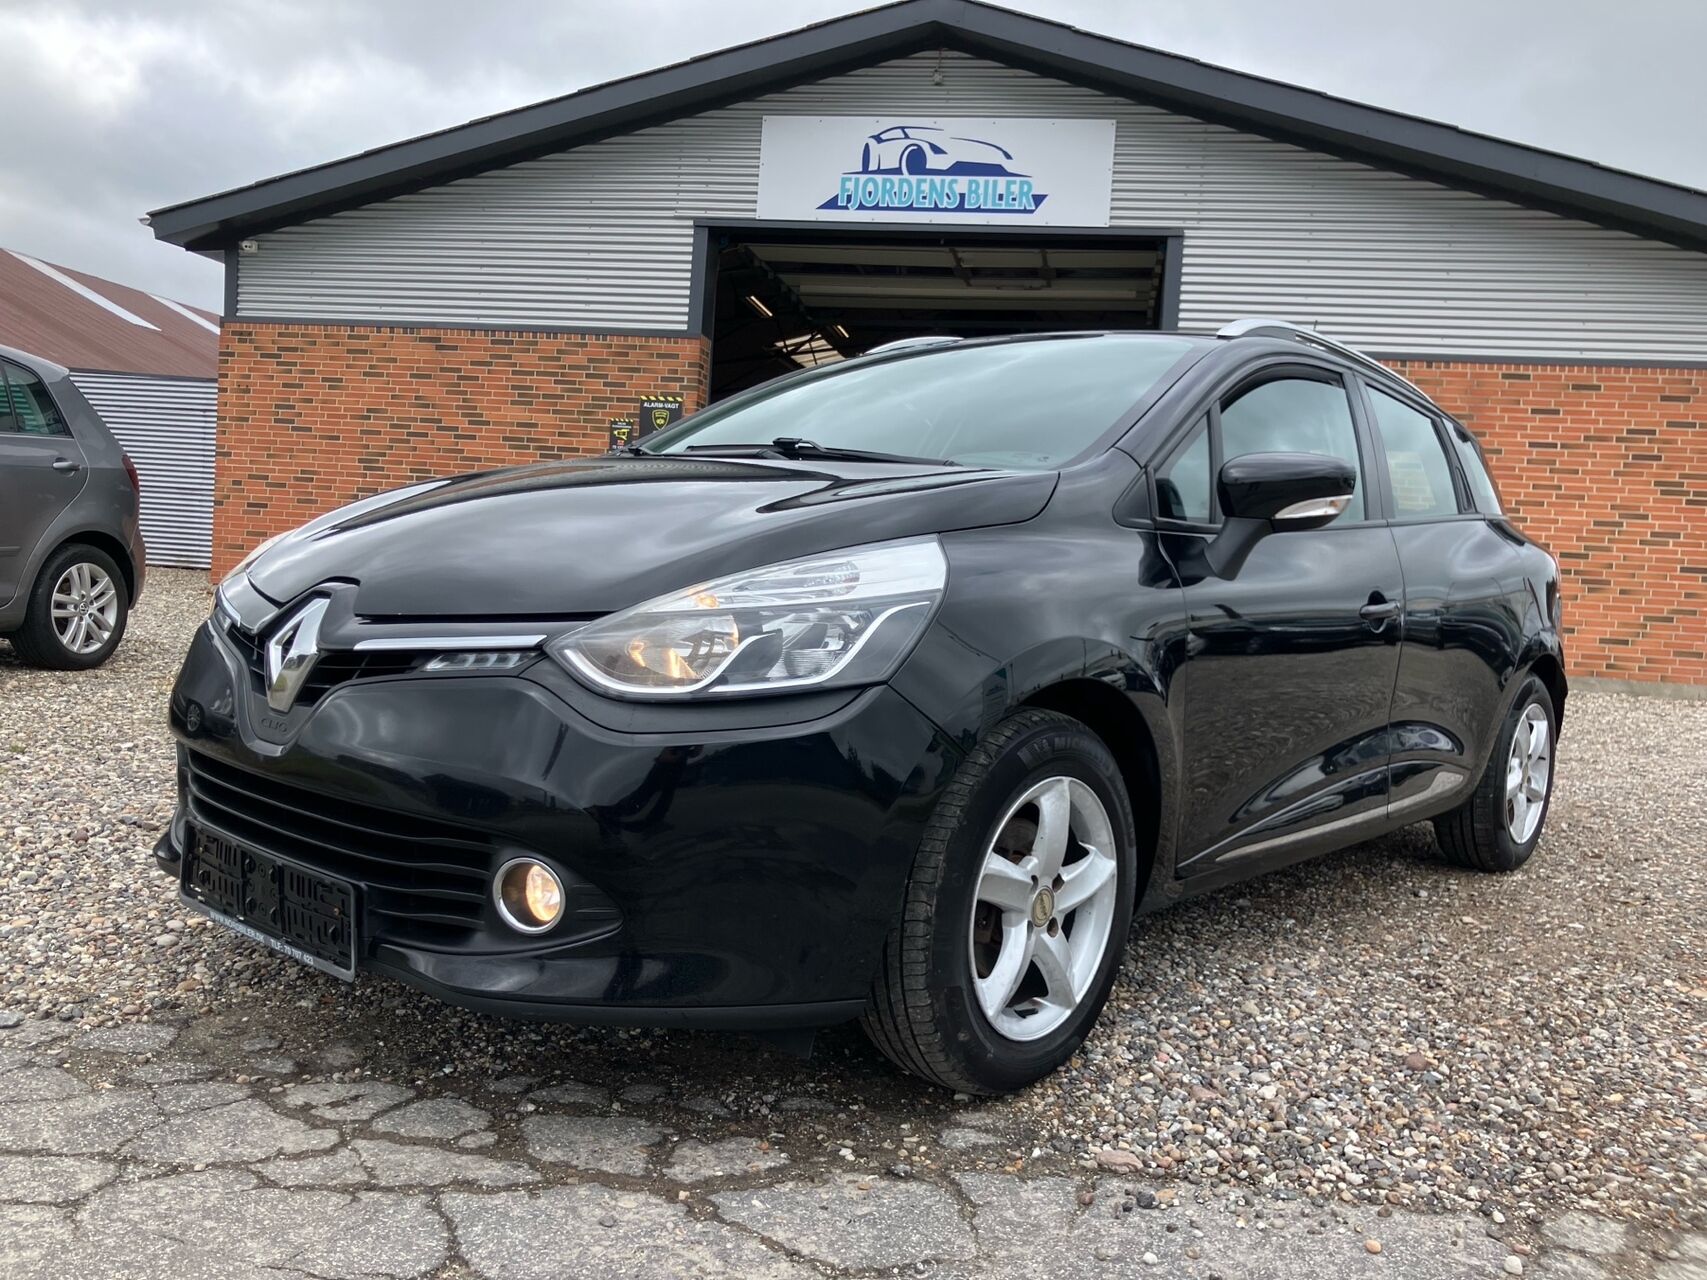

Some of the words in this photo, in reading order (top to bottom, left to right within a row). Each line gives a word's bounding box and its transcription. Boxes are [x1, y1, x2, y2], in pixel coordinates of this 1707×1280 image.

[838, 176, 960, 210] FJORDENS
[963, 178, 1036, 210] BILER
[643, 401, 680, 409] ALARM-VAGT
[261, 718, 289, 733] CLIO
